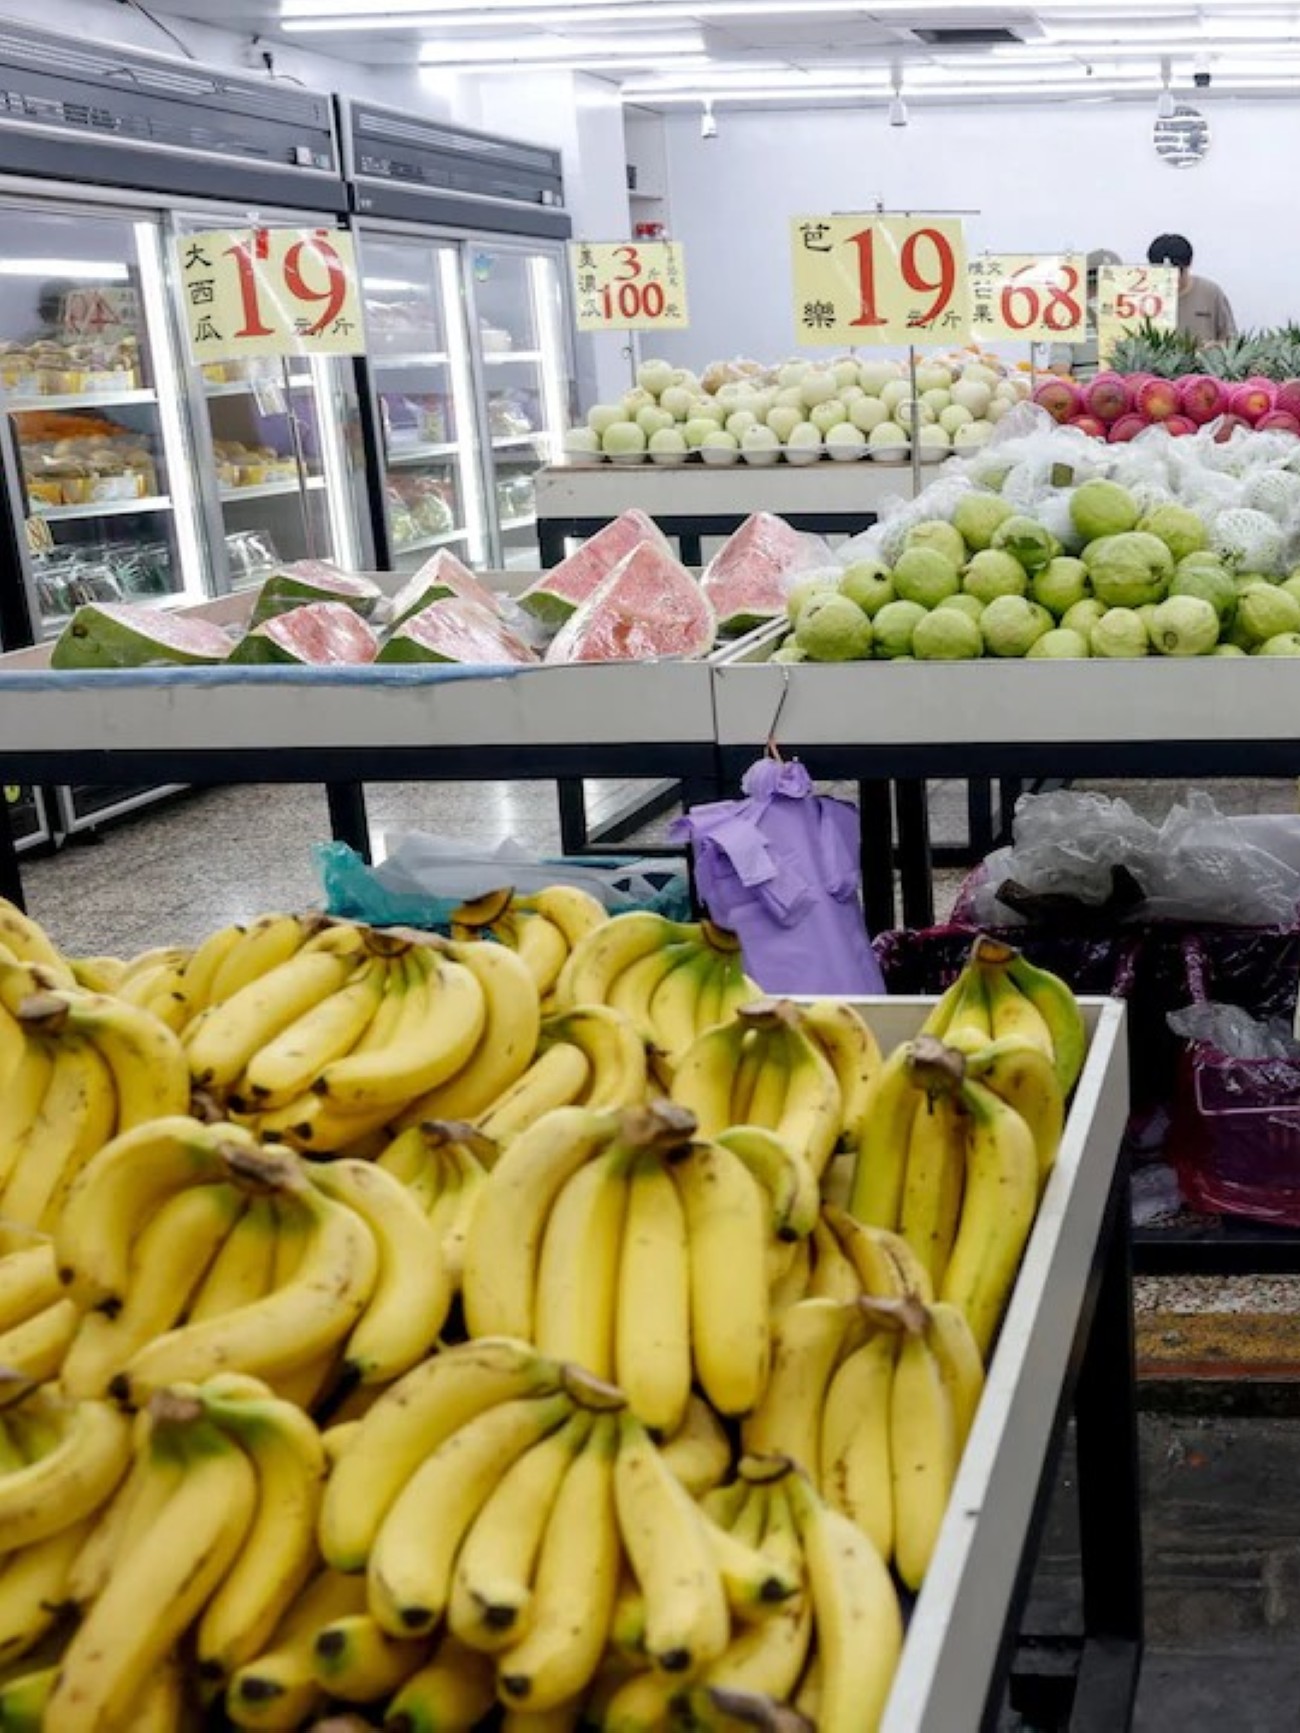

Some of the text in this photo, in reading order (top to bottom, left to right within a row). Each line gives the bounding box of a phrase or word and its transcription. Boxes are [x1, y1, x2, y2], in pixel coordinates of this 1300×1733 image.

[185, 243, 223, 342] 大西瓜
[222, 238, 346, 338] 19
[611, 247, 642, 281] 3
[799, 223, 837, 329] 芭樂
[843, 227, 956, 327] 19
[1001, 264, 1081, 331] 68
[1128, 268, 1149, 293] 2
[598, 282, 665, 319] 100
[1115, 294, 1163, 319] 50
